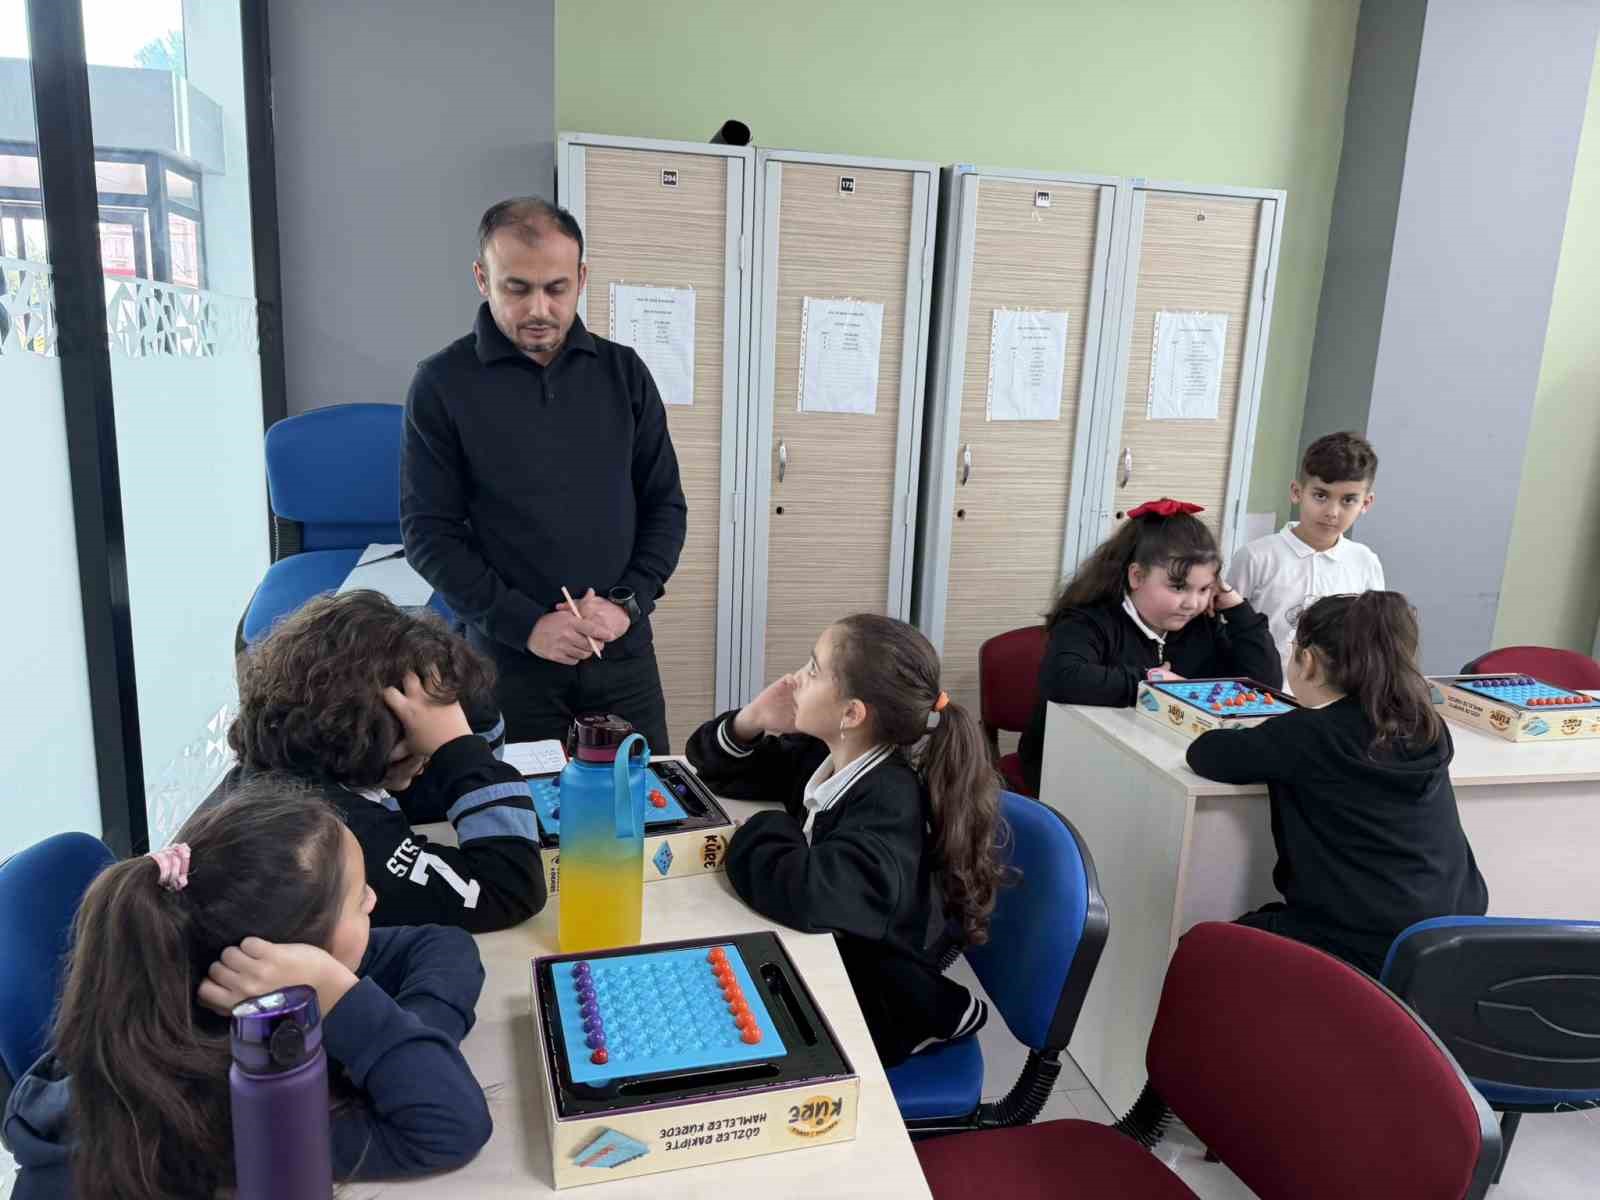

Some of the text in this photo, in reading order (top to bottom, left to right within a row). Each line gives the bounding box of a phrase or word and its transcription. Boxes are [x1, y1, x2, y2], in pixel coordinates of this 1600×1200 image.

[386, 837, 422, 878] STS
[704, 834, 721, 869] KÜRE
[409, 850, 481, 908] 7
[659, 1113, 767, 1139] HAMLELER KÜREDE
[788, 1097, 843, 1127] KÜRE
[665, 1127, 761, 1151] GÖZLER RAKİPTE
